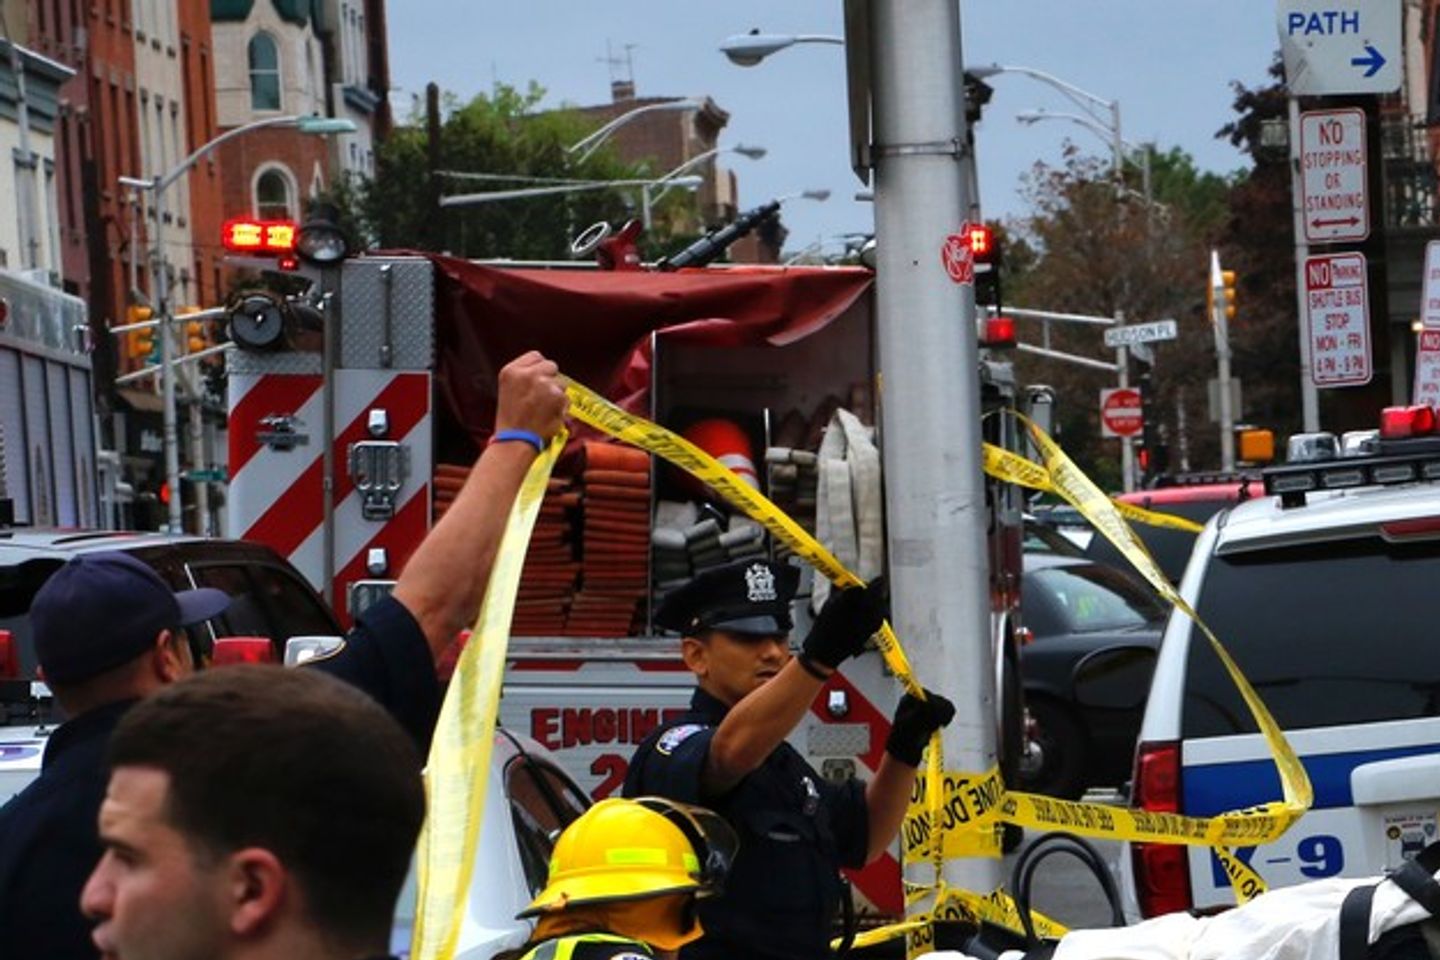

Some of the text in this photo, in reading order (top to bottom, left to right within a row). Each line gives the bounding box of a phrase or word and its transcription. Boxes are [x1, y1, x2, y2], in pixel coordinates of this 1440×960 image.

[1287, 11, 1360, 36] PATH
[1318, 121, 1343, 145] NO
[1304, 149, 1362, 170] STOPPING
[1325, 172, 1341, 190] OR
[1307, 193, 1363, 212] STANDING
[1309, 262, 1330, 287] NO
[1325, 312, 1350, 331] STOP
[1315, 336, 1338, 352] MON
[1347, 332, 1362, 349] FRI
[1423, 333, 1440, 350] NO
